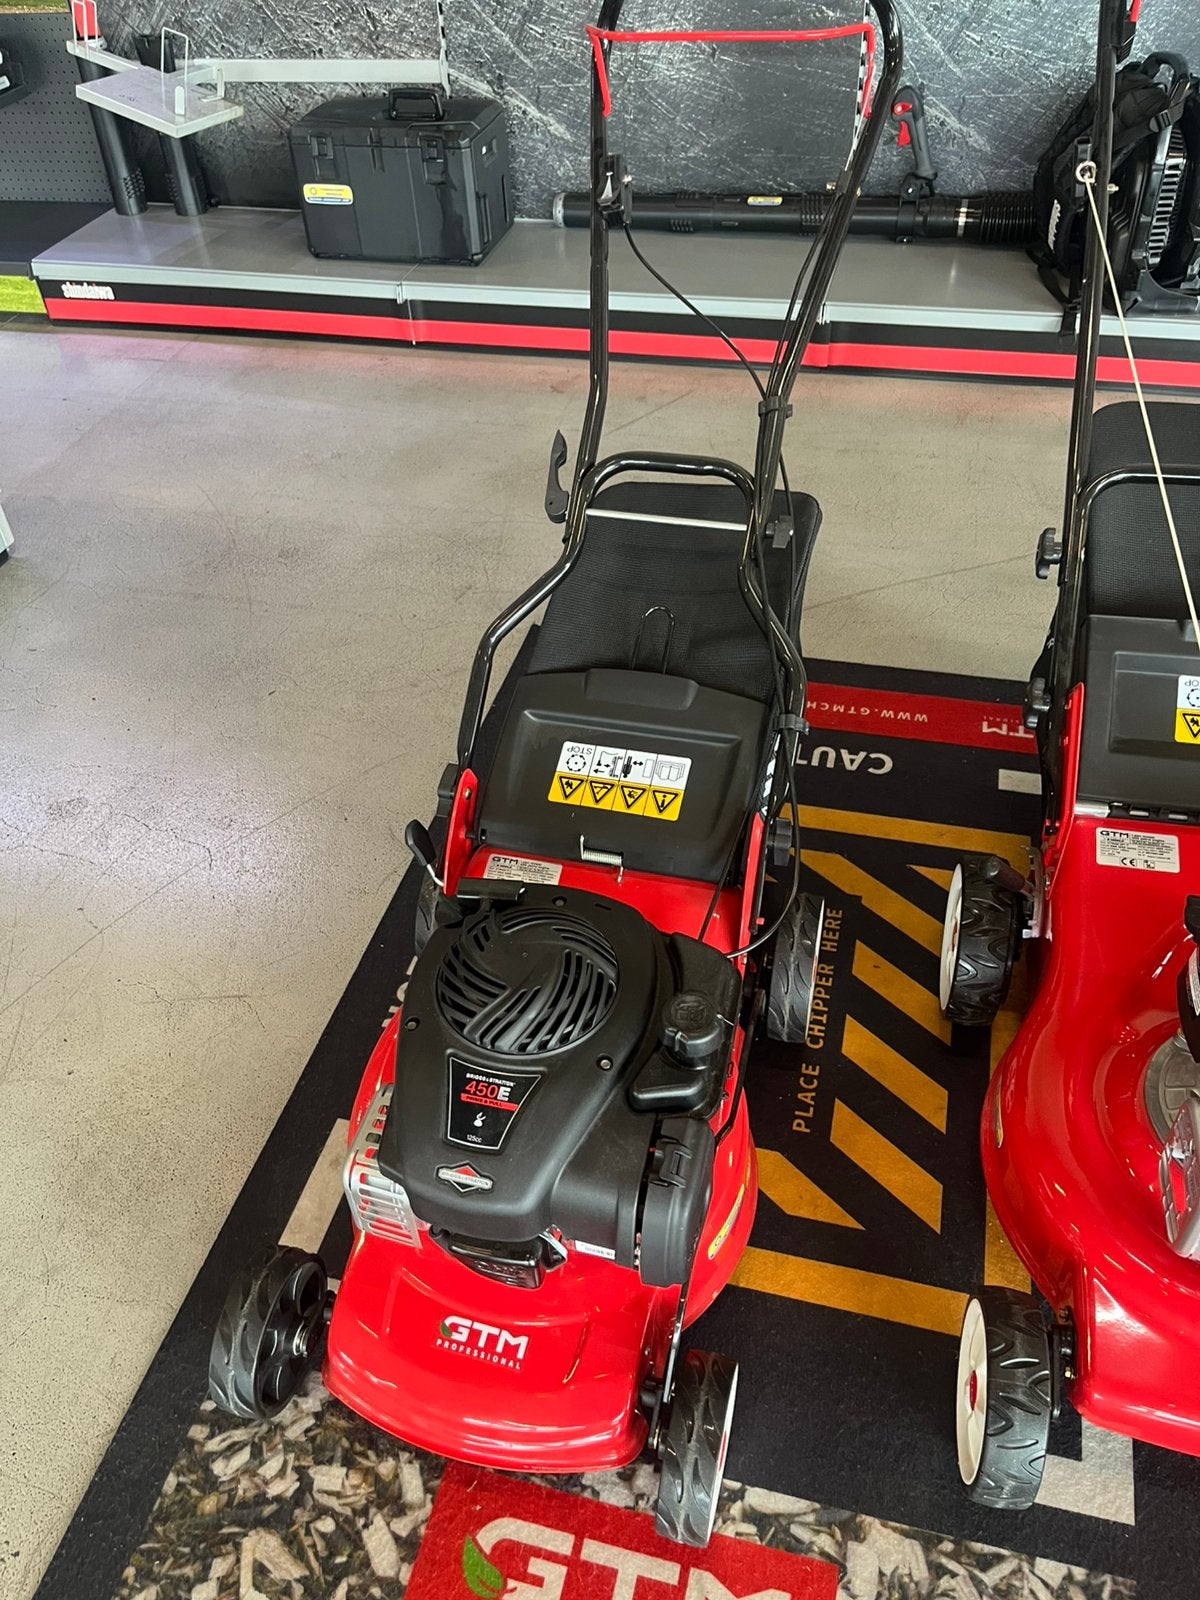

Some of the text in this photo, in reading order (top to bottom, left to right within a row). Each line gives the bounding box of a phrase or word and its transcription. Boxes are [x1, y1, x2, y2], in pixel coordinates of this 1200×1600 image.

[1184, 679, 1200, 688] OP
[982, 721, 1034, 739] TM
[566, 742, 593, 755] STOP
[1100, 830, 1129, 838] GTM
[492, 856, 519, 865] GTM
[792, 907, 843, 1133] PLACE CHIPPER HERE
[465, 1080, 512, 1101] 450E
[466, 1134, 483, 1143] 125cc
[440, 1315, 529, 1360] GTM
[436, 1338, 521, 1370] PROFESSIONAL
